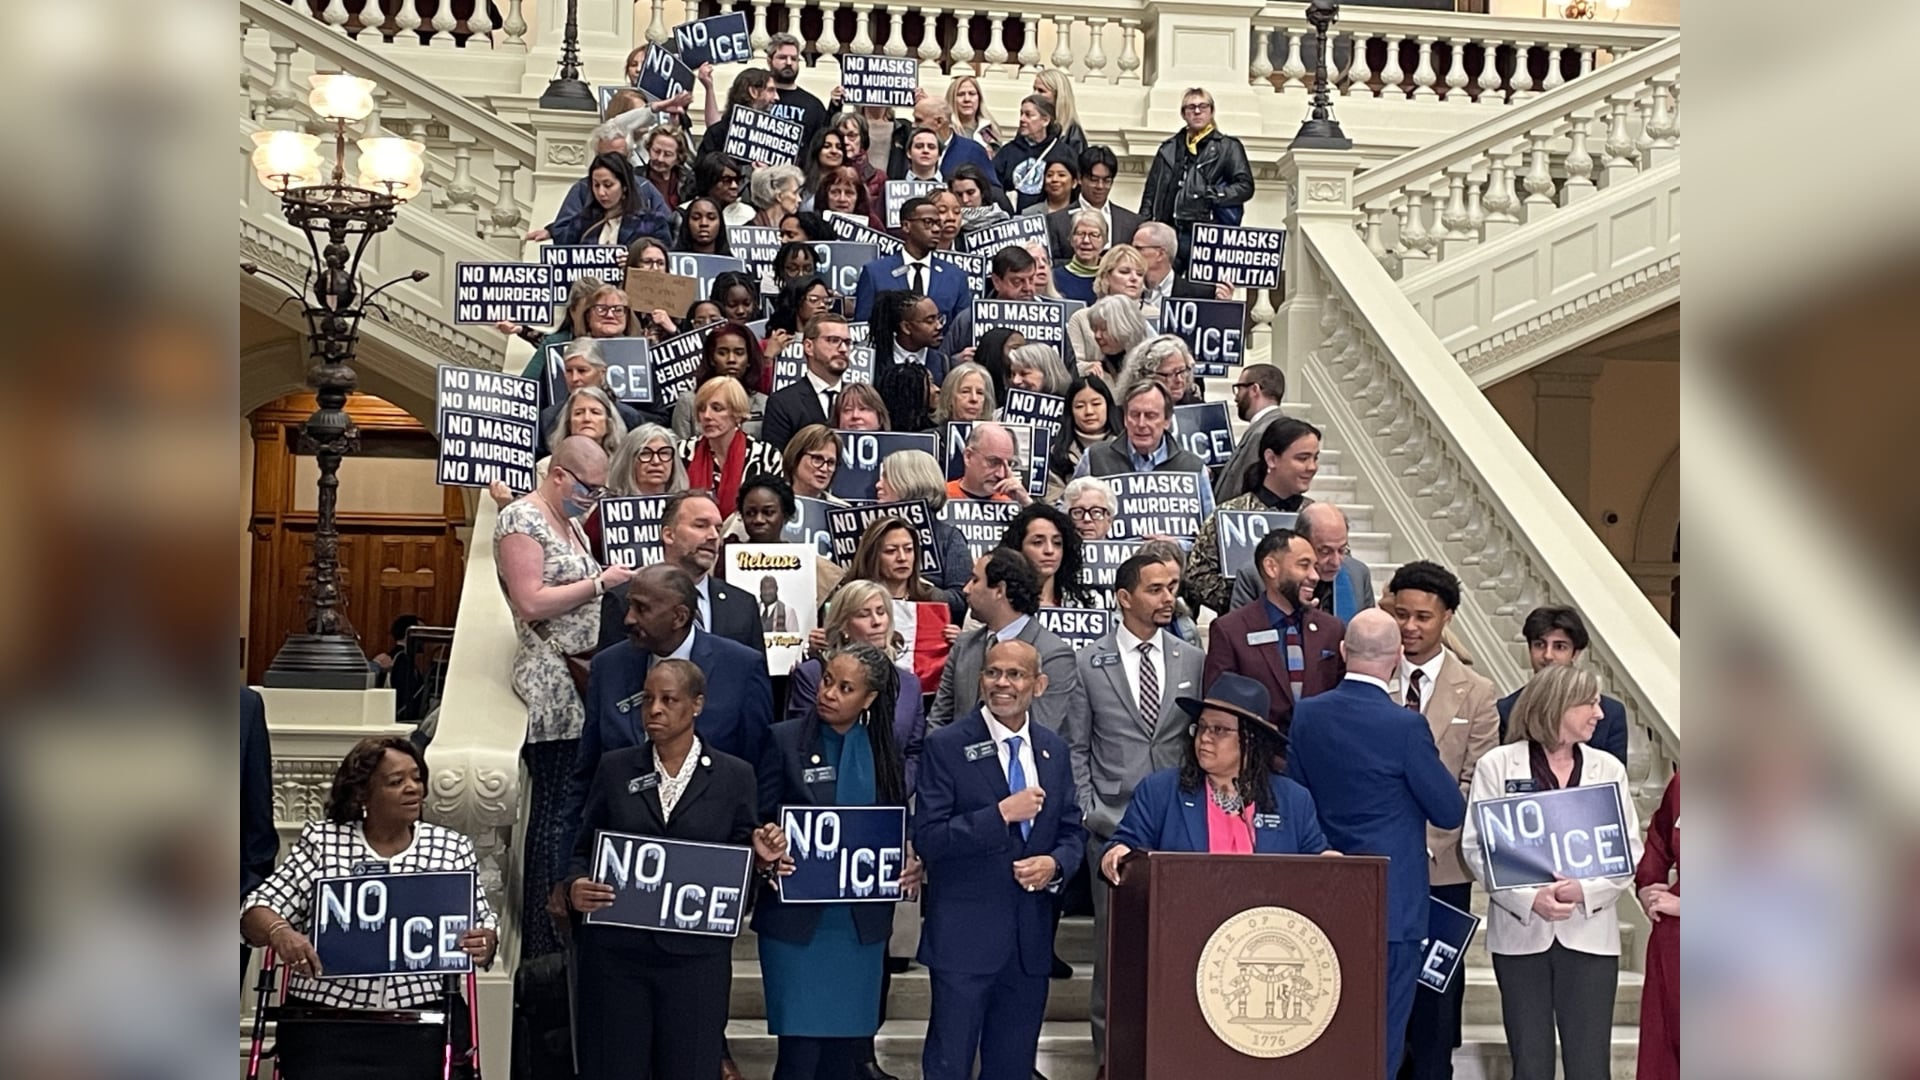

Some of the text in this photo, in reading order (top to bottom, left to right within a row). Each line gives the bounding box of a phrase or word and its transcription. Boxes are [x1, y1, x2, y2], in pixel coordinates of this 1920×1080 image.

[677, 22, 707, 50] NO
[709, 33, 748, 62] ICE
[646, 44, 674, 79] NO
[846, 57, 914, 74] NO MASKS
[844, 74, 916, 88] NO MURDERS
[844, 88, 914, 105] NO MILITIA
[736, 109, 800, 140] NO MASKS
[730, 125, 799, 155] NO MURDERS
[728, 140, 792, 166] NO MILITIA
[891, 184, 910, 196] NO
[731, 230, 750, 244] NO
[833, 219, 853, 239] NO
[967, 217, 1043, 248] NO MILITIA
[1197, 227, 1279, 249] NO MASKS
[546, 249, 568, 265] NO
[730, 248, 747, 260] NO
[815, 244, 831, 273] O
[1192, 247, 1280, 267] NO MURDERS
[462, 266, 549, 284] NO MASKS
[554, 268, 563, 282] O
[831, 265, 861, 295] IC
[1192, 264, 1275, 286] NO MILITIA
[459, 286, 551, 302] NO MURDERS
[553, 286, 567, 302] O
[460, 304, 548, 322] NO MILITIA
[977, 303, 1060, 322] NO MASKS
[1163, 301, 1197, 334] NO
[649, 333, 704, 365] MILITI
[782, 342, 804, 359] NO
[1194, 327, 1241, 362] ICE
[777, 361, 797, 376] NO
[445, 370, 536, 400] NO MASKS
[606, 364, 648, 398] CE
[441, 392, 537, 422] NO MURDERS
[1011, 393, 1036, 412] NO
[448, 415, 531, 447] NO MASKS
[444, 439, 534, 468] NO MURDERS
[1181, 429, 1232, 461] ICE
[443, 460, 532, 491] NO MILITIA
[1104, 475, 1194, 496] O MASKS
[606, 502, 633, 522] NO
[954, 502, 1020, 522] MASKS
[1123, 497, 1199, 515] MURDERS
[832, 513, 857, 533] NO
[1131, 517, 1200, 537] MILITIA
[1222, 514, 1270, 547] NO
[606, 526, 629, 545] NO
[835, 538, 856, 555] NO
[609, 549, 637, 567] NO
[736, 551, 802, 572] Release
[785, 811, 841, 860] NO
[1482, 800, 1546, 853] NO
[1550, 824, 1625, 875] ICE
[599, 837, 666, 892] NO
[839, 847, 902, 897] ICE
[321, 880, 387, 933] NO
[659, 882, 740, 932] ICE
[388, 915, 468, 971] ICE
[1208, 916, 1332, 997] STATE OF GEORGIA
[1252, 1035, 1286, 1047] 1776
